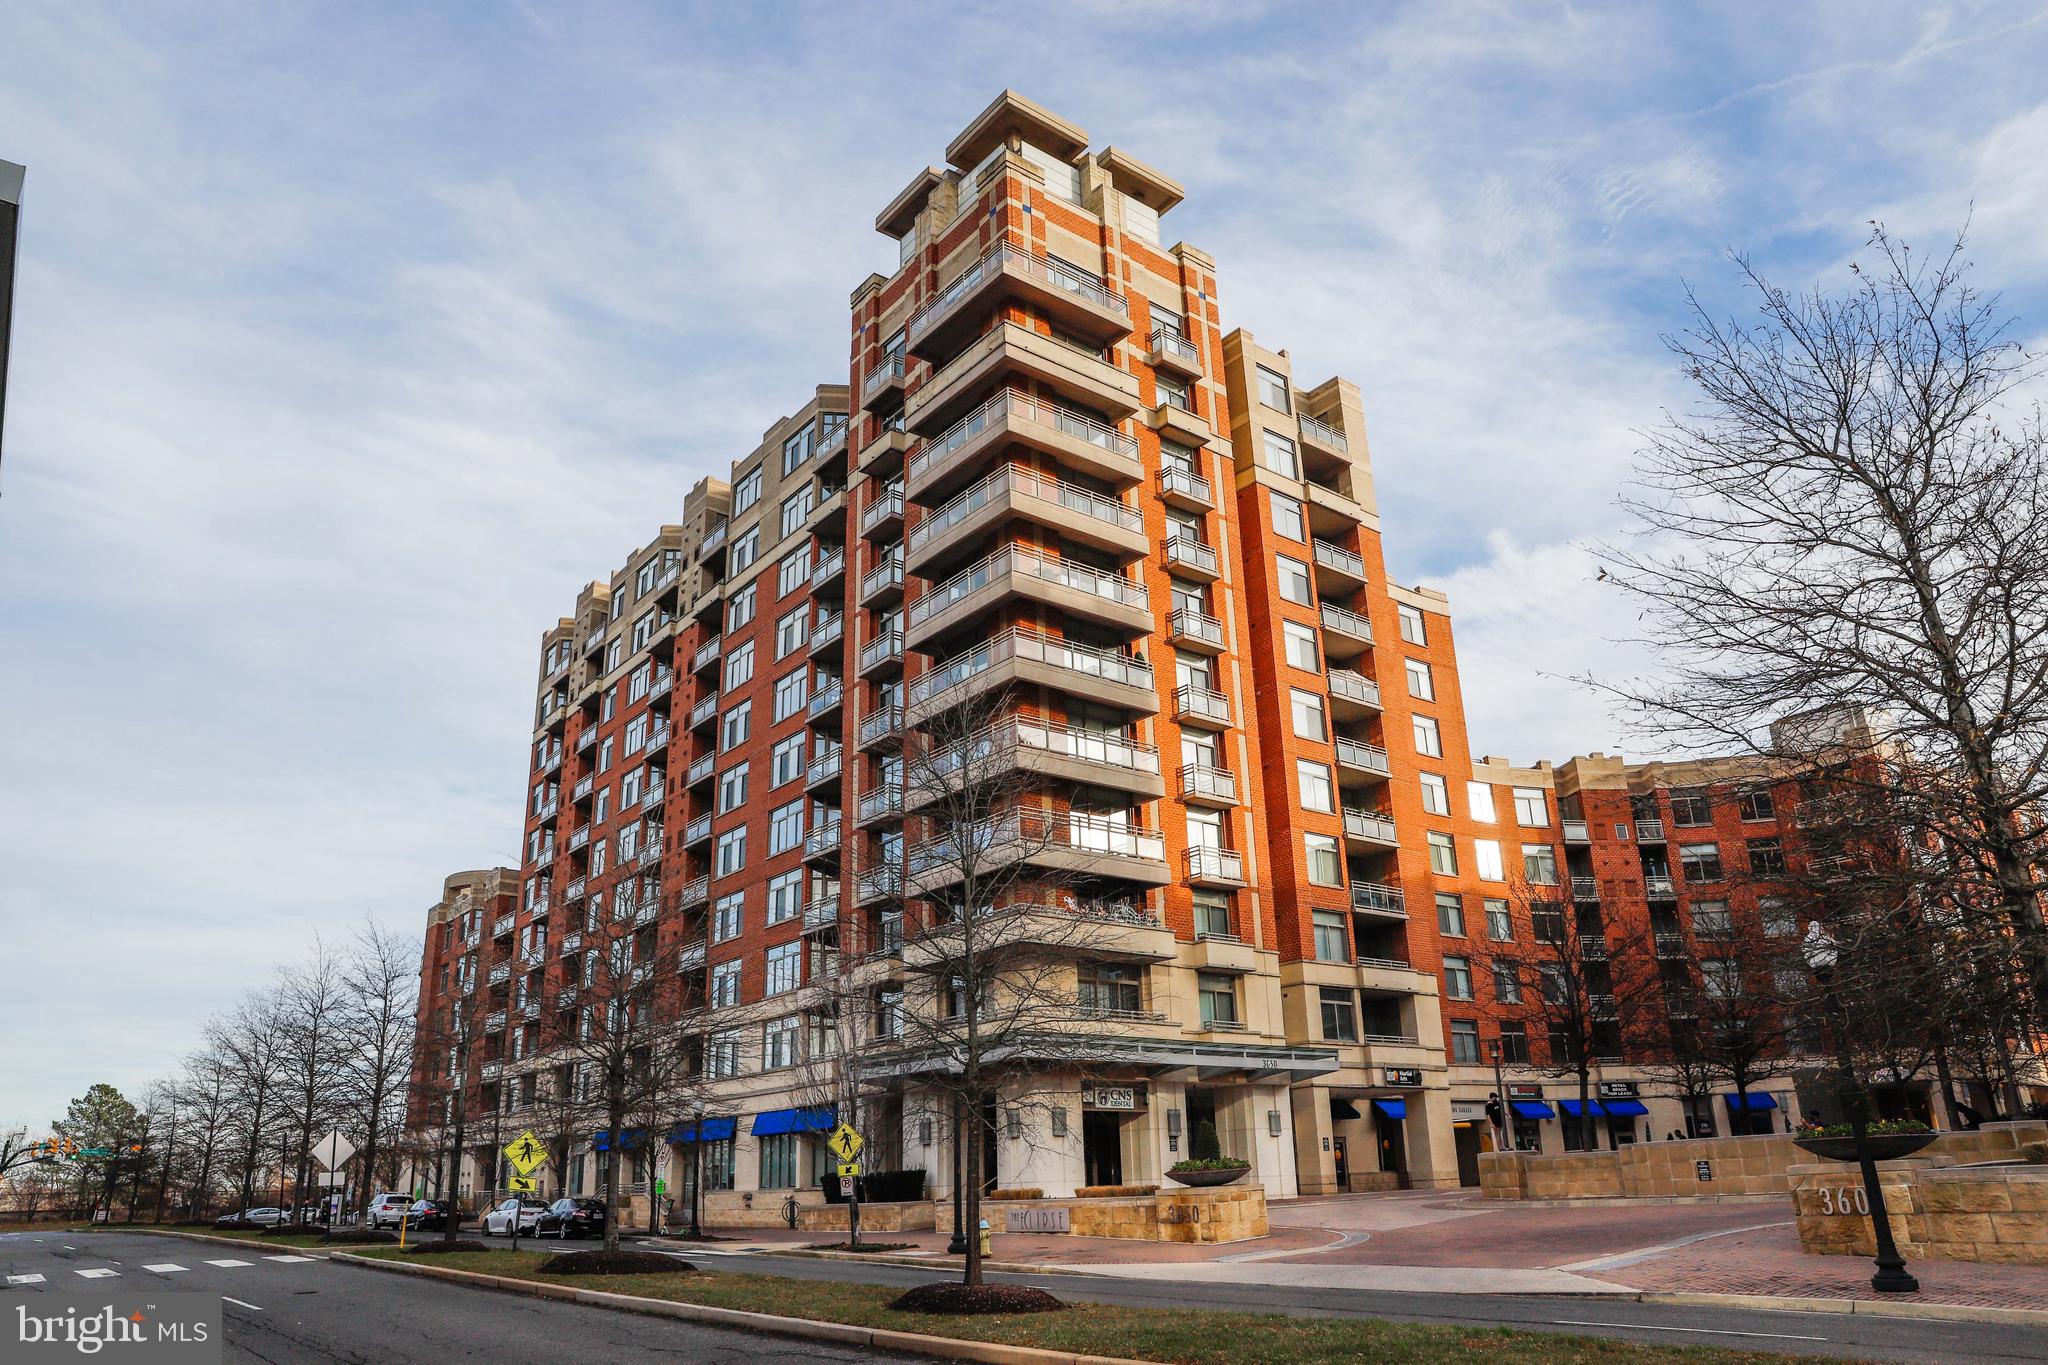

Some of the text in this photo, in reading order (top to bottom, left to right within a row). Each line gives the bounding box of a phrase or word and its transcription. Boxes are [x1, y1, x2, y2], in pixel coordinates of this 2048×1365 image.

[1110, 1089, 1132, 1101] CNS
[1818, 1187, 1887, 1215] 360
[1011, 1209, 1063, 1230] THE ECLIPSE
